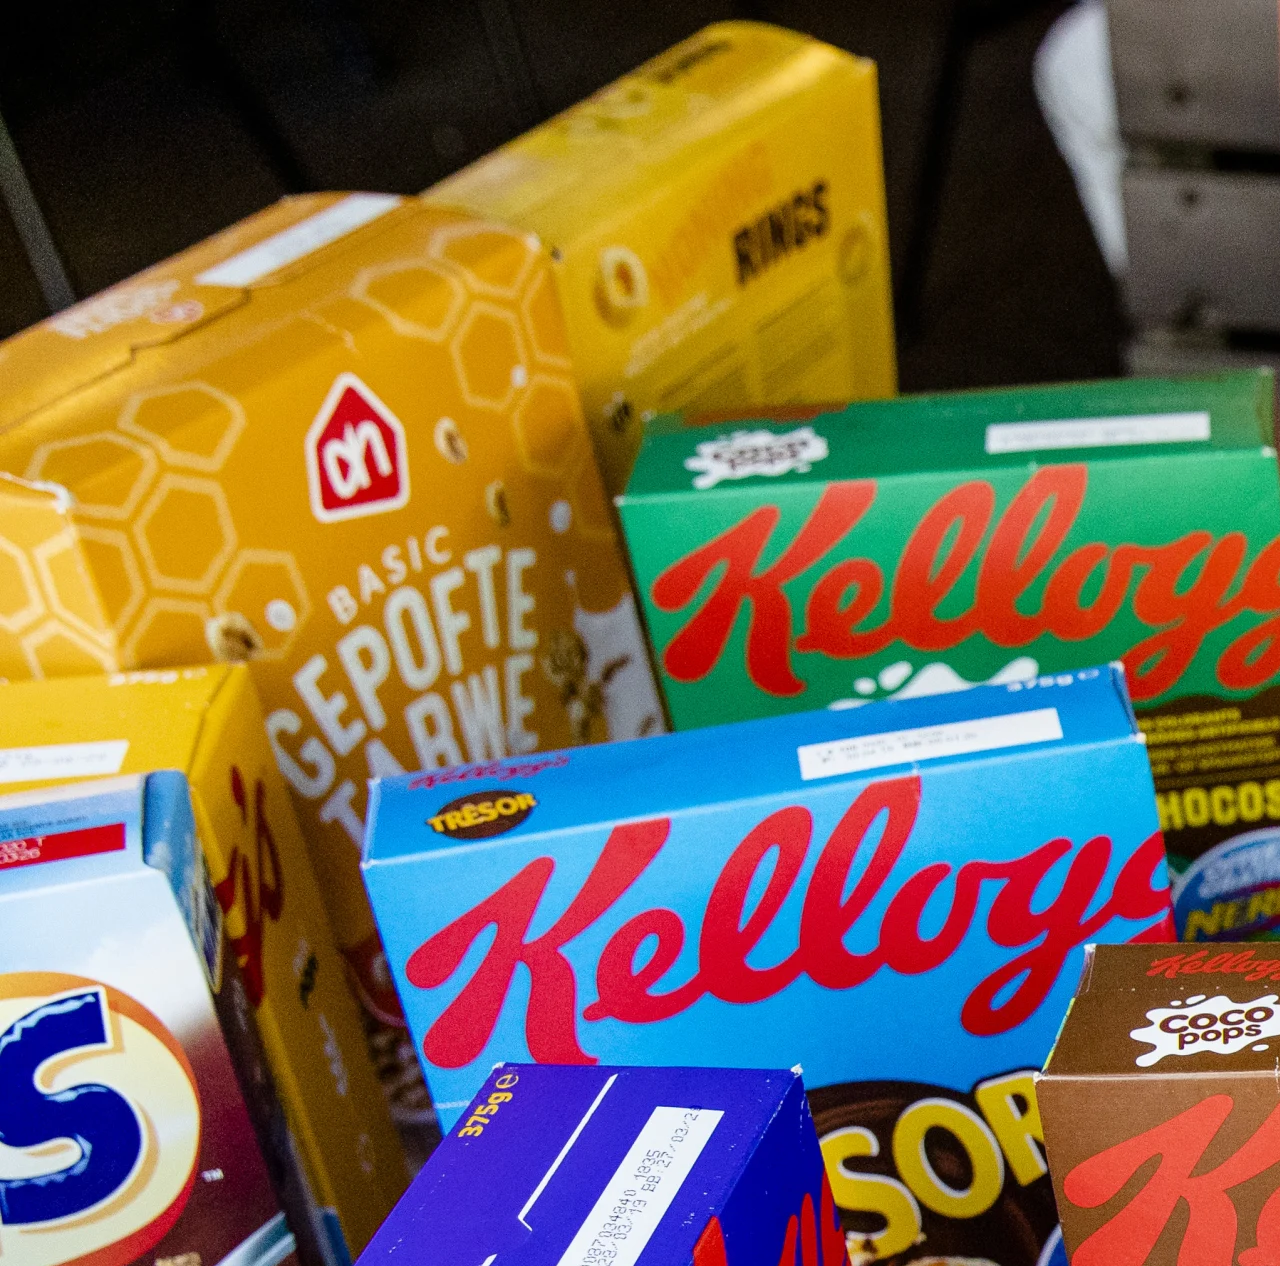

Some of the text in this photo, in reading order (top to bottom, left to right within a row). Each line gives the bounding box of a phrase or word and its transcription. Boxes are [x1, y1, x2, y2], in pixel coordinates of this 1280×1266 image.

[733, 180, 832, 287] RINGS
[328, 526, 453, 622] BASIC
[264, 546, 540, 798] GEPOFTE
[1177, 1025, 1261, 1052] pops
[458, 1098, 510, 1139] 375g
